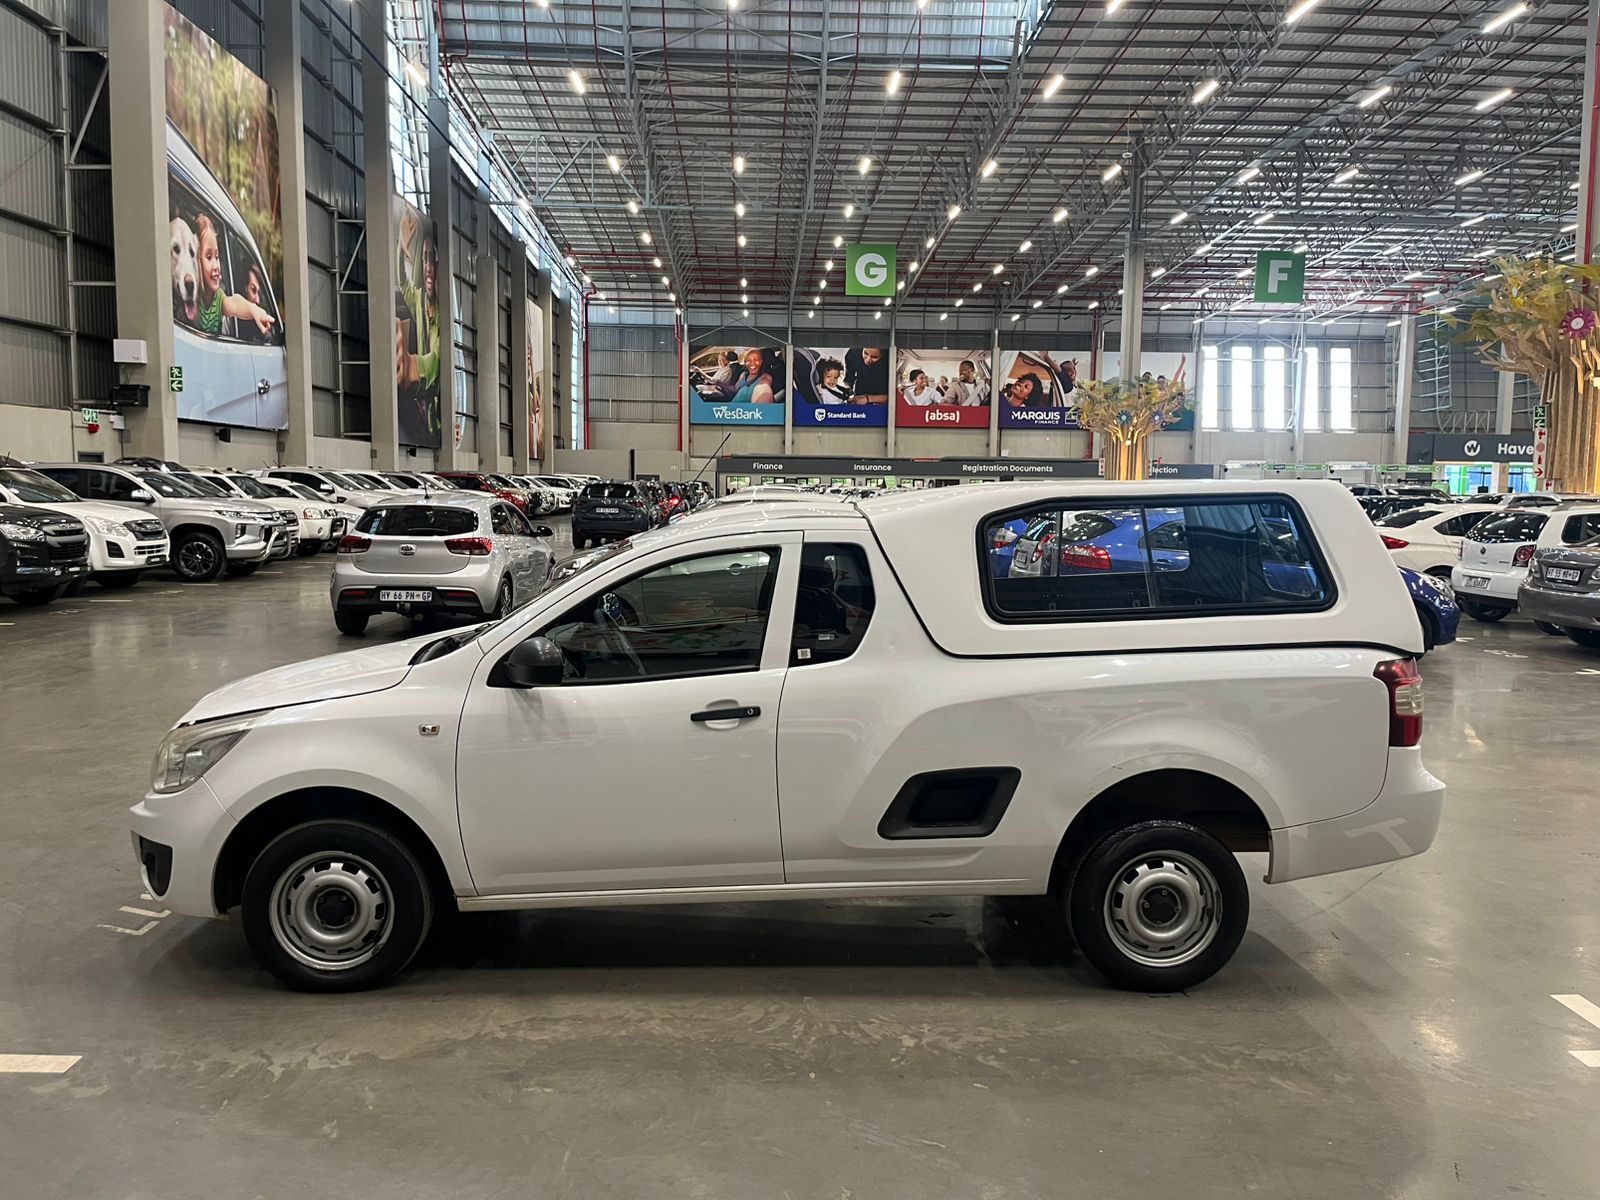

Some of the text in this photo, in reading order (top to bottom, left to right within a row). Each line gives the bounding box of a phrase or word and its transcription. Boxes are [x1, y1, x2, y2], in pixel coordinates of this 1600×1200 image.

[854, 252, 888, 288] G
[1268, 260, 1292, 294] F
[712, 406, 762, 420] WesBank
[1011, 411, 1060, 420] MARQUIS
[1498, 443, 1534, 455] Have
[854, 464, 892, 472] Insurance
[962, 464, 1053, 473] Registration Documents
[382, 592, 432, 600] HY 66 PN GP
